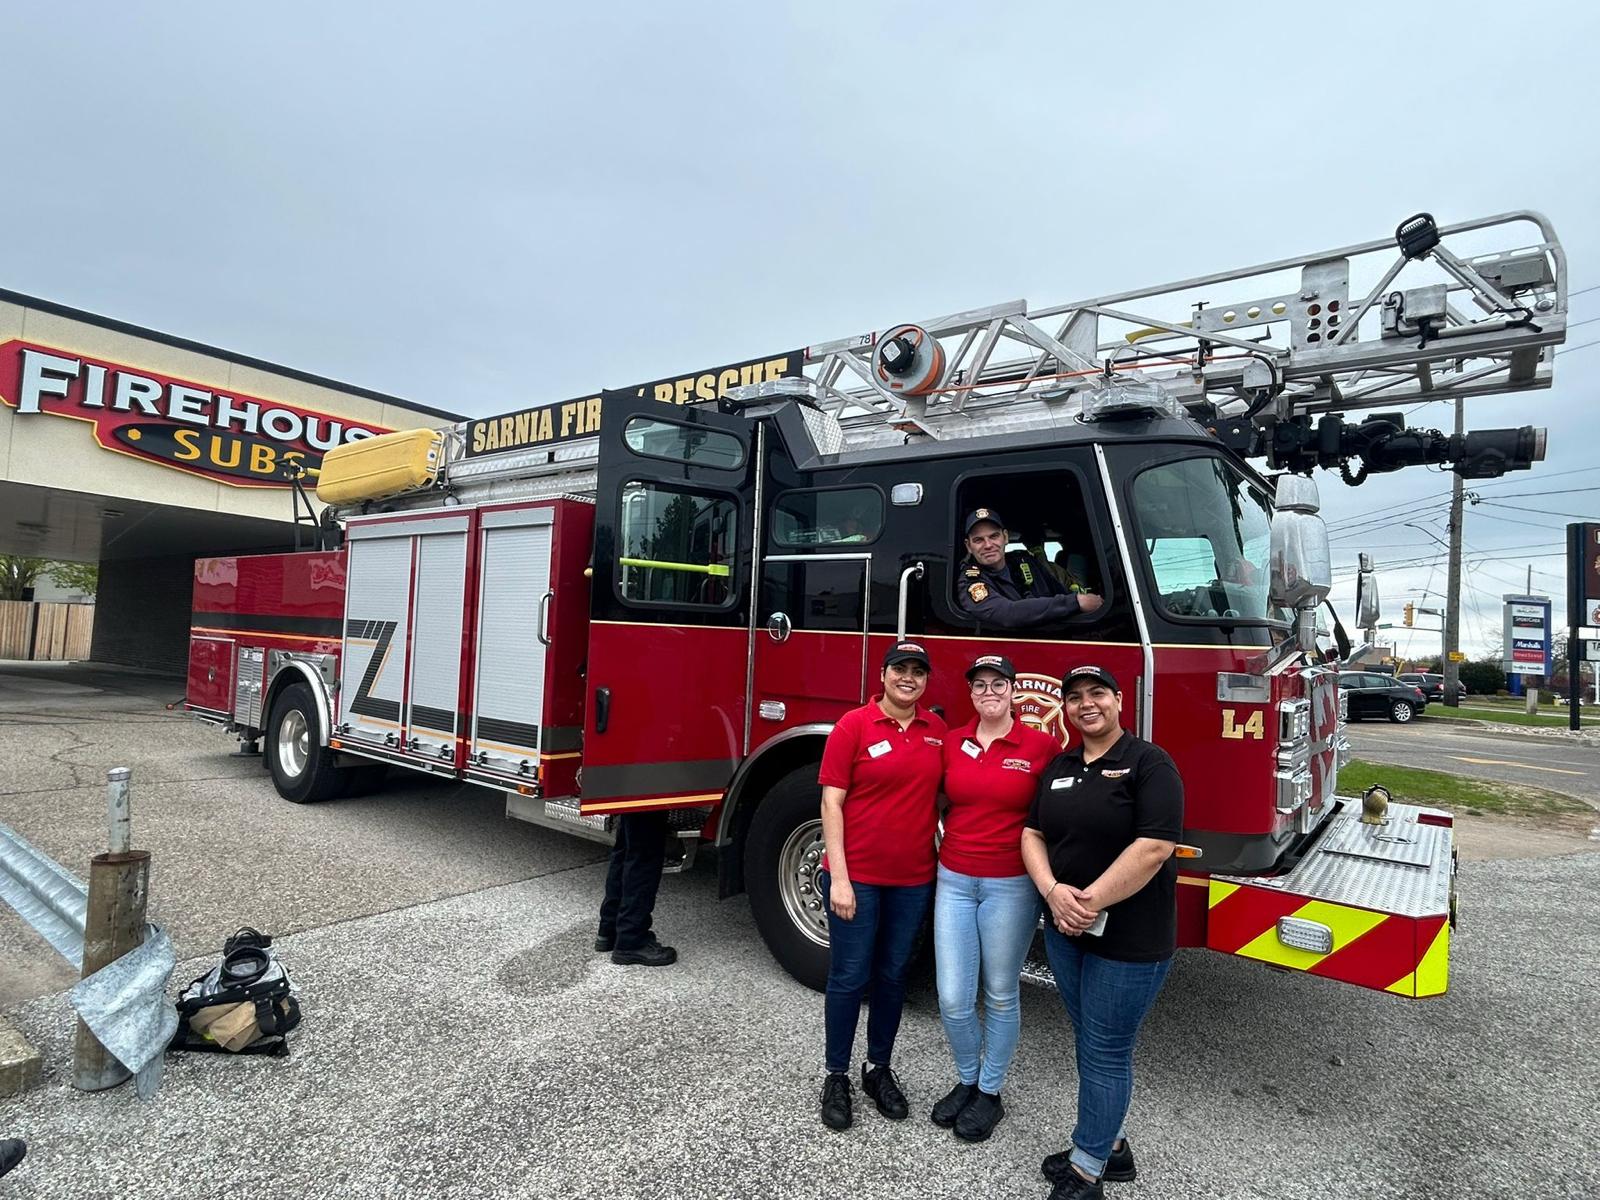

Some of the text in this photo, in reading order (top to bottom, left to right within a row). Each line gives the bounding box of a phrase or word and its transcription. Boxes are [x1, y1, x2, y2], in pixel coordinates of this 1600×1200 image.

[859, 334, 871, 345] 78
[16, 348, 378, 450] FIREHOU
[472, 408, 554, 453] SARNIA
[560, 398, 602, 437] FIR
[1013, 680, 1062, 698] ARNIA
[1021, 704, 1040, 714] FIRE
[1222, 709, 1264, 739] L4
